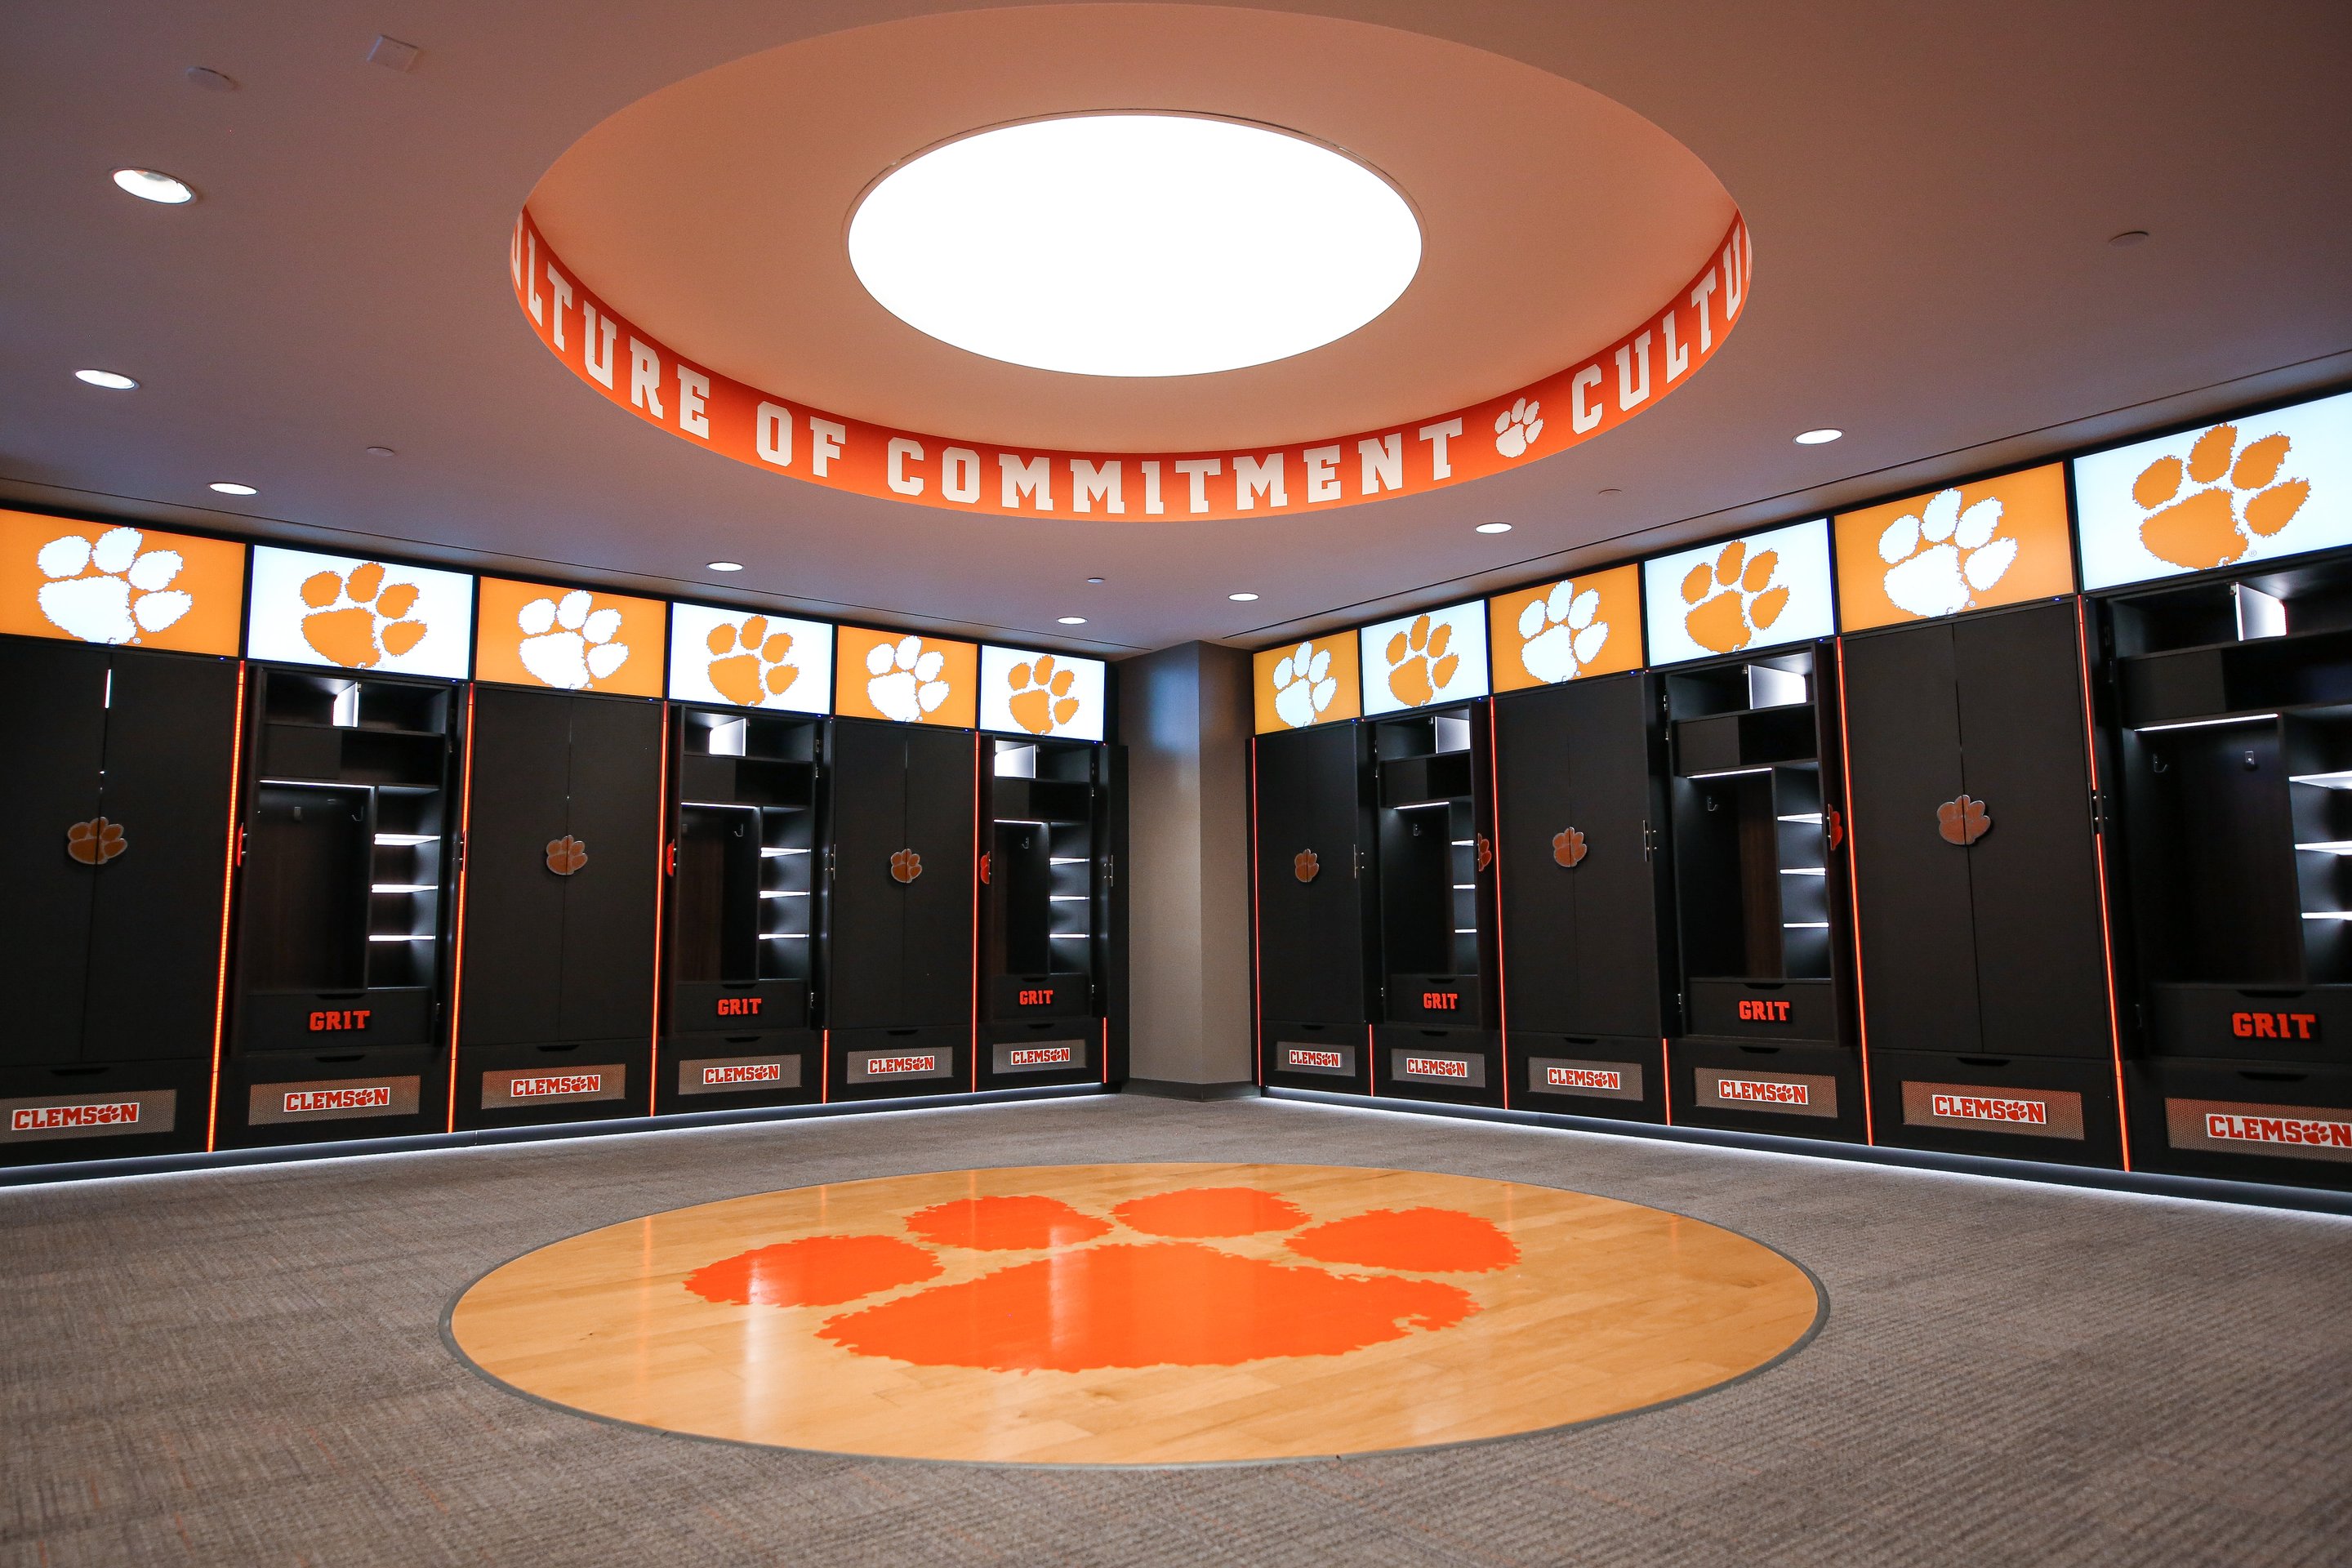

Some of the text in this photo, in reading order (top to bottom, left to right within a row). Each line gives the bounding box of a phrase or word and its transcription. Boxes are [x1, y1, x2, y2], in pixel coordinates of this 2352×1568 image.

[755, 400, 846, 479] OF
[887, 417, 1463, 514] COMMITMENT
[717, 997, 763, 1016] GRIT
[1018, 989, 1054, 1005] GRIT
[1423, 992, 1459, 1010] GRIT
[309, 1009, 372, 1031] GRIT
[1738, 1000, 1792, 1022] GRIT
[2231, 1012, 2316, 1040] GRIT
